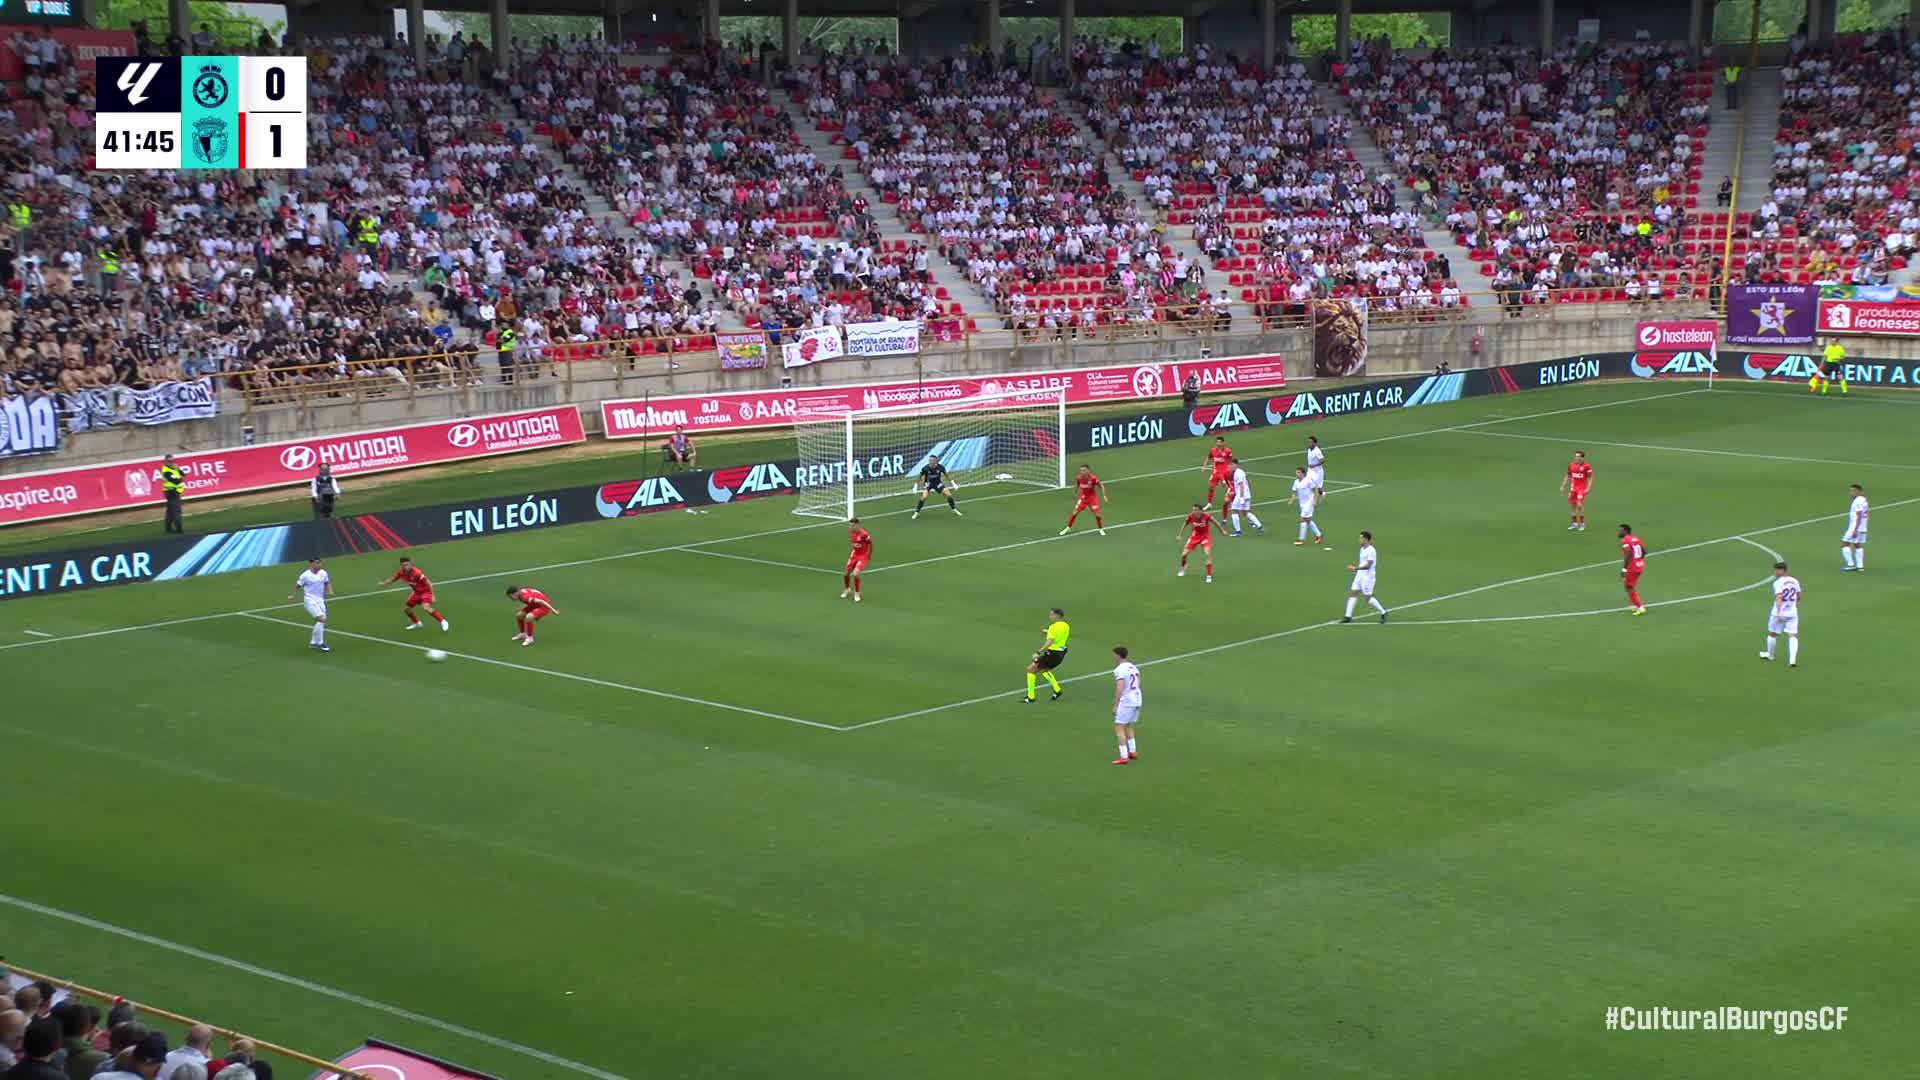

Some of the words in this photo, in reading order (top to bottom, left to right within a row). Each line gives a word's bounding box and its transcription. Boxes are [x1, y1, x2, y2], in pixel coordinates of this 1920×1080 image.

[1854, 315, 1920, 330] leoneses
[1857, 307, 1920, 321] productos
[1662, 328, 1713, 343] hosteleón
[1540, 365, 1558, 385] EN
[1561, 357, 1599, 382] LEÓN
[1660, 352, 1719, 373] ALA
[1771, 355, 1826, 378] ALA
[1890, 366, 1907, 384] A
[1004, 376, 1073, 393] ASPIRE
[1203, 366, 1237, 385] AAR
[756, 398, 798, 419] AAR
[1015, 392, 1062, 402] ACADEM
[1285, 393, 1322, 418] ALA
[1325, 392, 1360, 414] RENT
[1363, 391, 1373, 409] A
[1376, 386, 1403, 406] CAR
[482, 415, 559, 441] HYUNDAI
[612, 406, 689, 430] Mahou
[693, 414, 732, 425] TOSTADA
[1210, 403, 1249, 429] ALA
[1091, 426, 1112, 448] EN
[1118, 416, 1163, 444] LEÓN
[318, 435, 406, 463] HYUNDAI
[152, 461, 227, 482] APIRE
[727, 463, 792, 494] ALA
[796, 461, 845, 488] RENT
[851, 459, 864, 479] A
[868, 454, 905, 478] CAR
[626, 477, 685, 509] ALA
[450, 508, 484, 536] EN
[492, 494, 558, 530] LEÓN
[59, 559, 83, 587] A
[91, 551, 152, 582] CAR
[1782, 587, 1797, 602] 22
